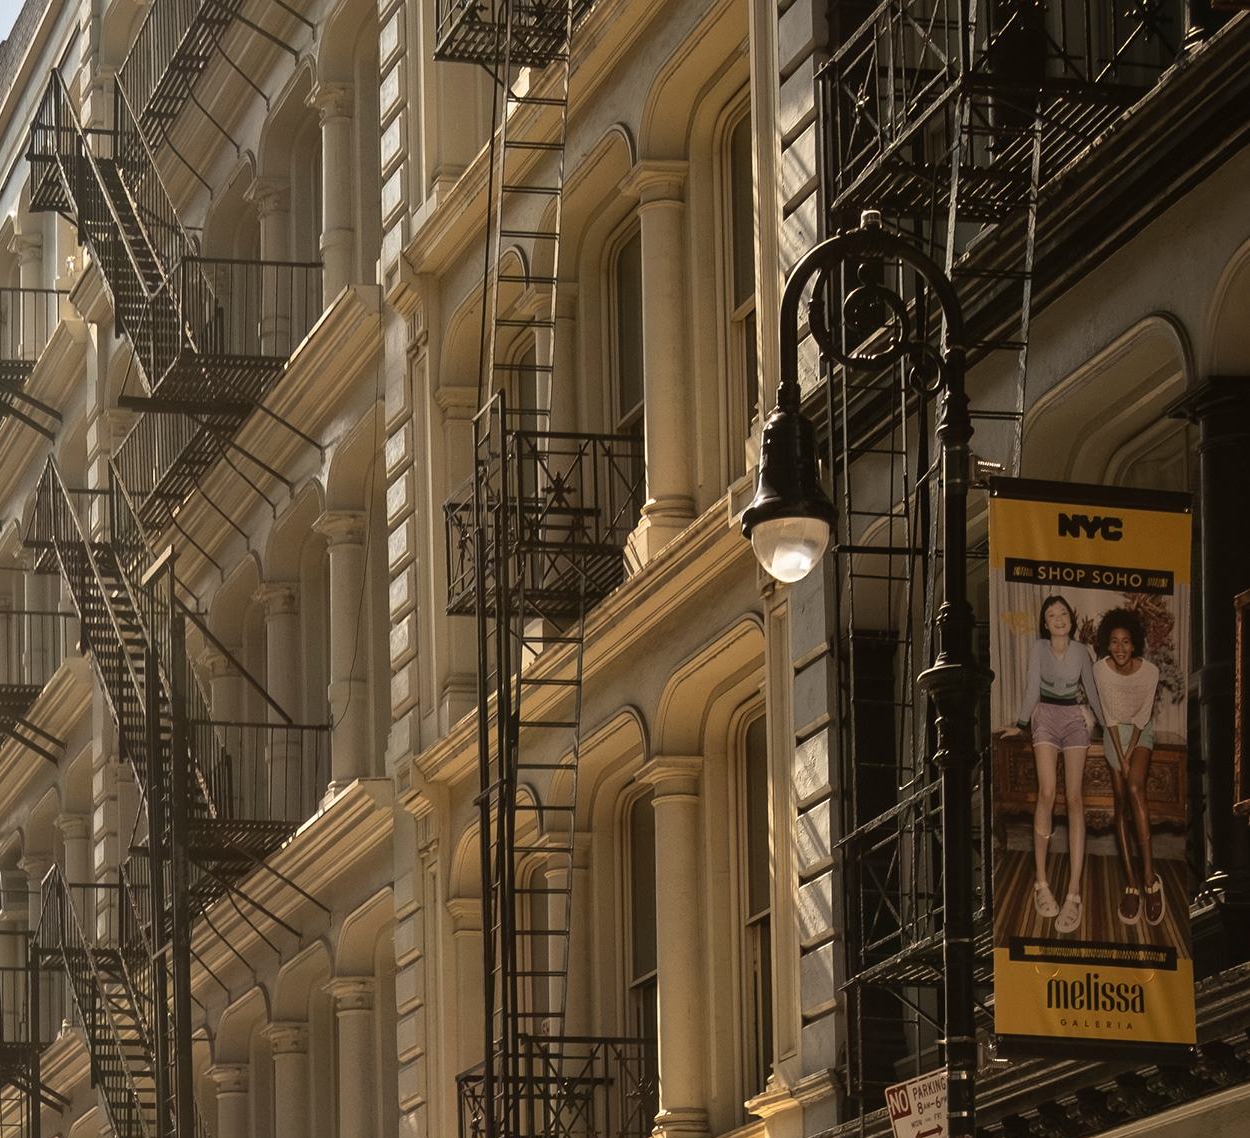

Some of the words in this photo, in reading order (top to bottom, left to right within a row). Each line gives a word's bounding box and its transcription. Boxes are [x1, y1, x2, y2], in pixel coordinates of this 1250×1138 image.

[1058, 512, 1123, 541] NYC
[1037, 566, 1086, 582] SHOP
[1092, 570, 1143, 587] SOHO
[1046, 972, 1145, 1014] melissa
[1060, 1018, 1133, 1030] GALERIA
[889, 1089, 909, 1116] NO
[912, 1077, 947, 1101] PARKING
